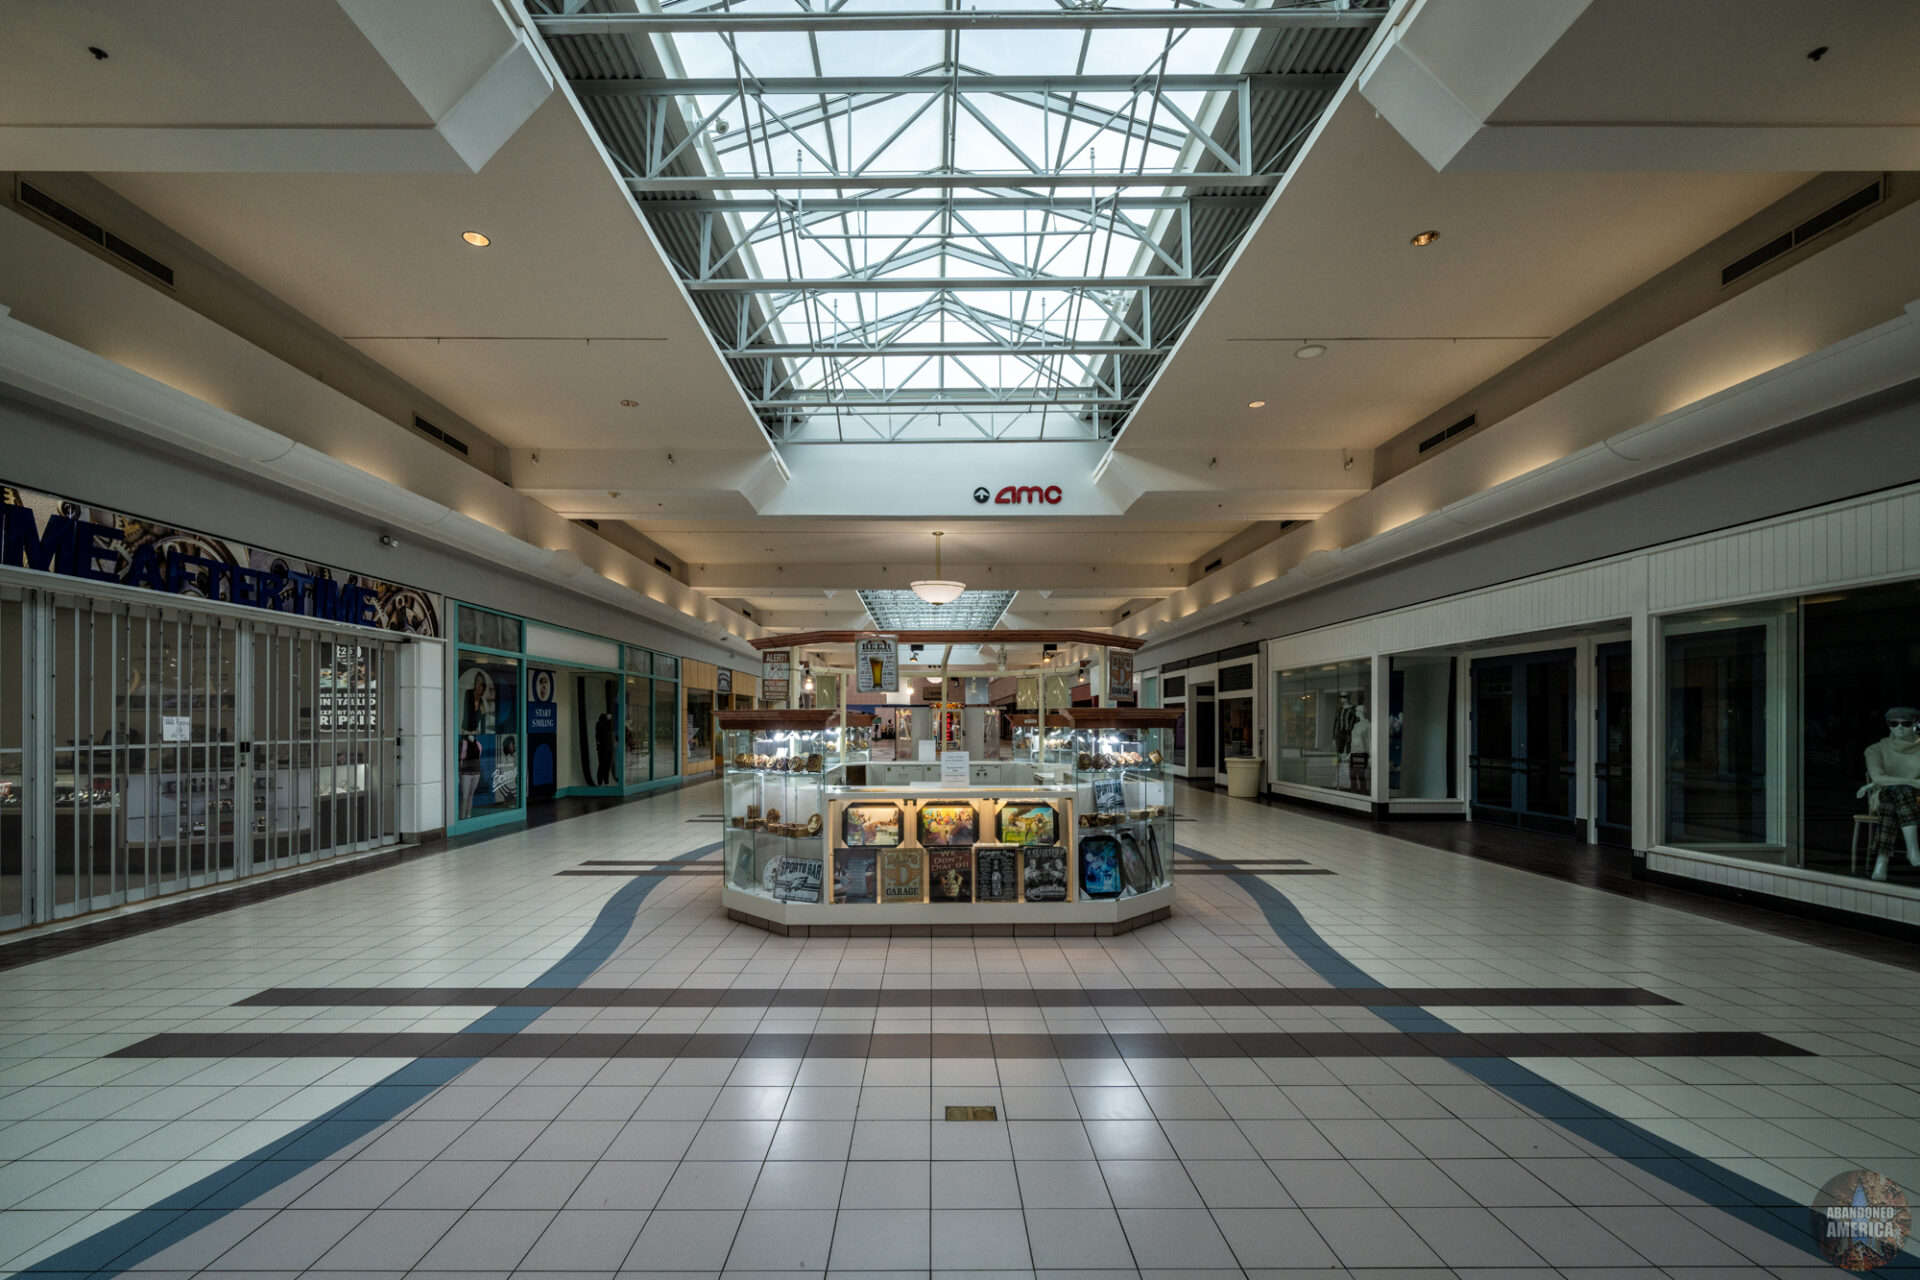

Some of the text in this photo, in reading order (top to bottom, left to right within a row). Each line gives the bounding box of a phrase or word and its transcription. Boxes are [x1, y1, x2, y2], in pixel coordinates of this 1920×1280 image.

[0, 503, 380, 626] ME AFTER TIME
[320, 698, 376, 706] INTALLD
[535, 708, 552, 717] START
[531, 719, 554, 727] SMILING
[886, 888, 919, 897] GARAGE
